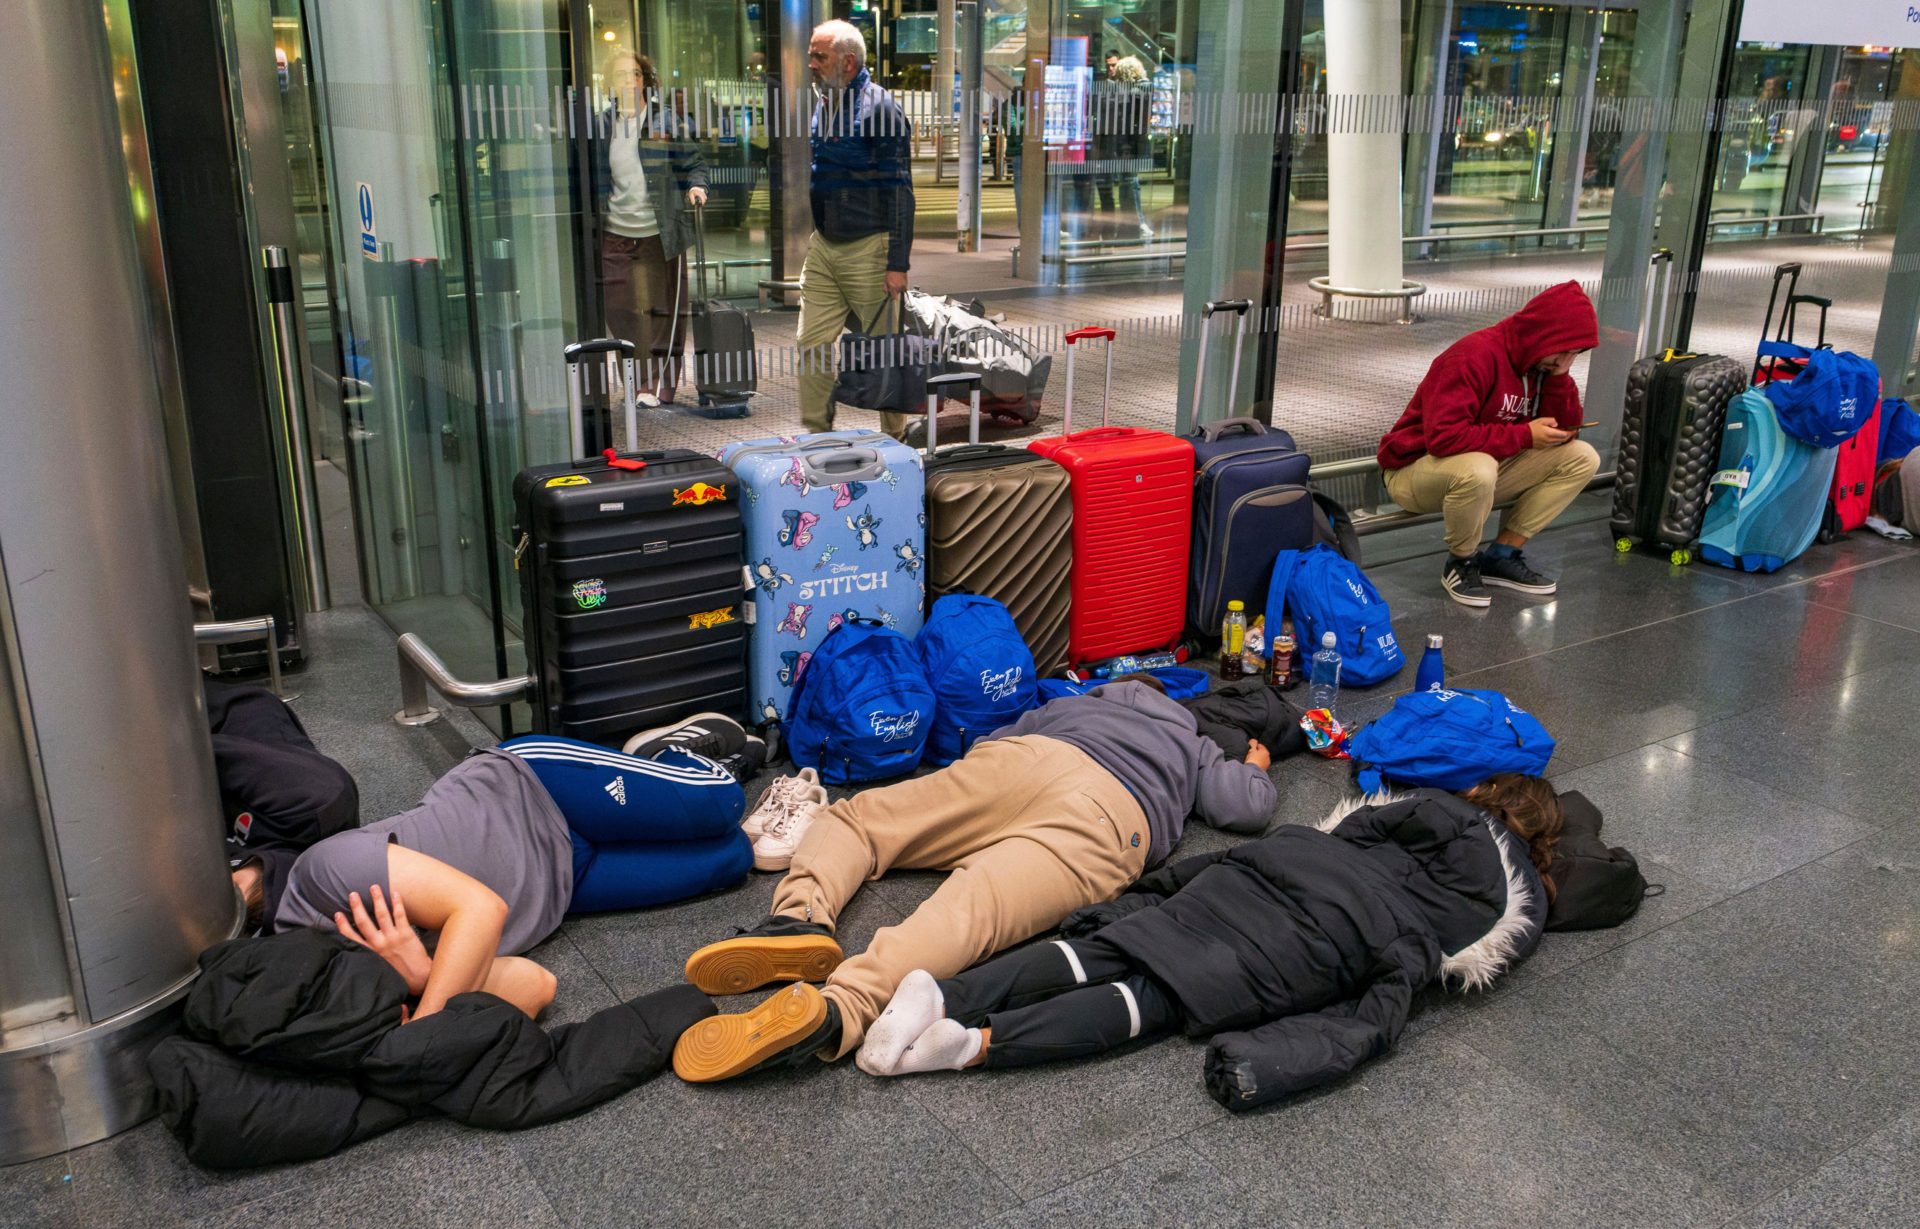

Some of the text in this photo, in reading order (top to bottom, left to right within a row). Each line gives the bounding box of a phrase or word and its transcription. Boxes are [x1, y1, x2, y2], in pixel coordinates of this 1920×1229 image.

[1906, 6, 1920, 23] Po
[829, 563, 859, 574] Disney
[799, 571, 888, 600] STITCH
[874, 709, 920, 743] English
[616, 775, 626, 805] adidas
